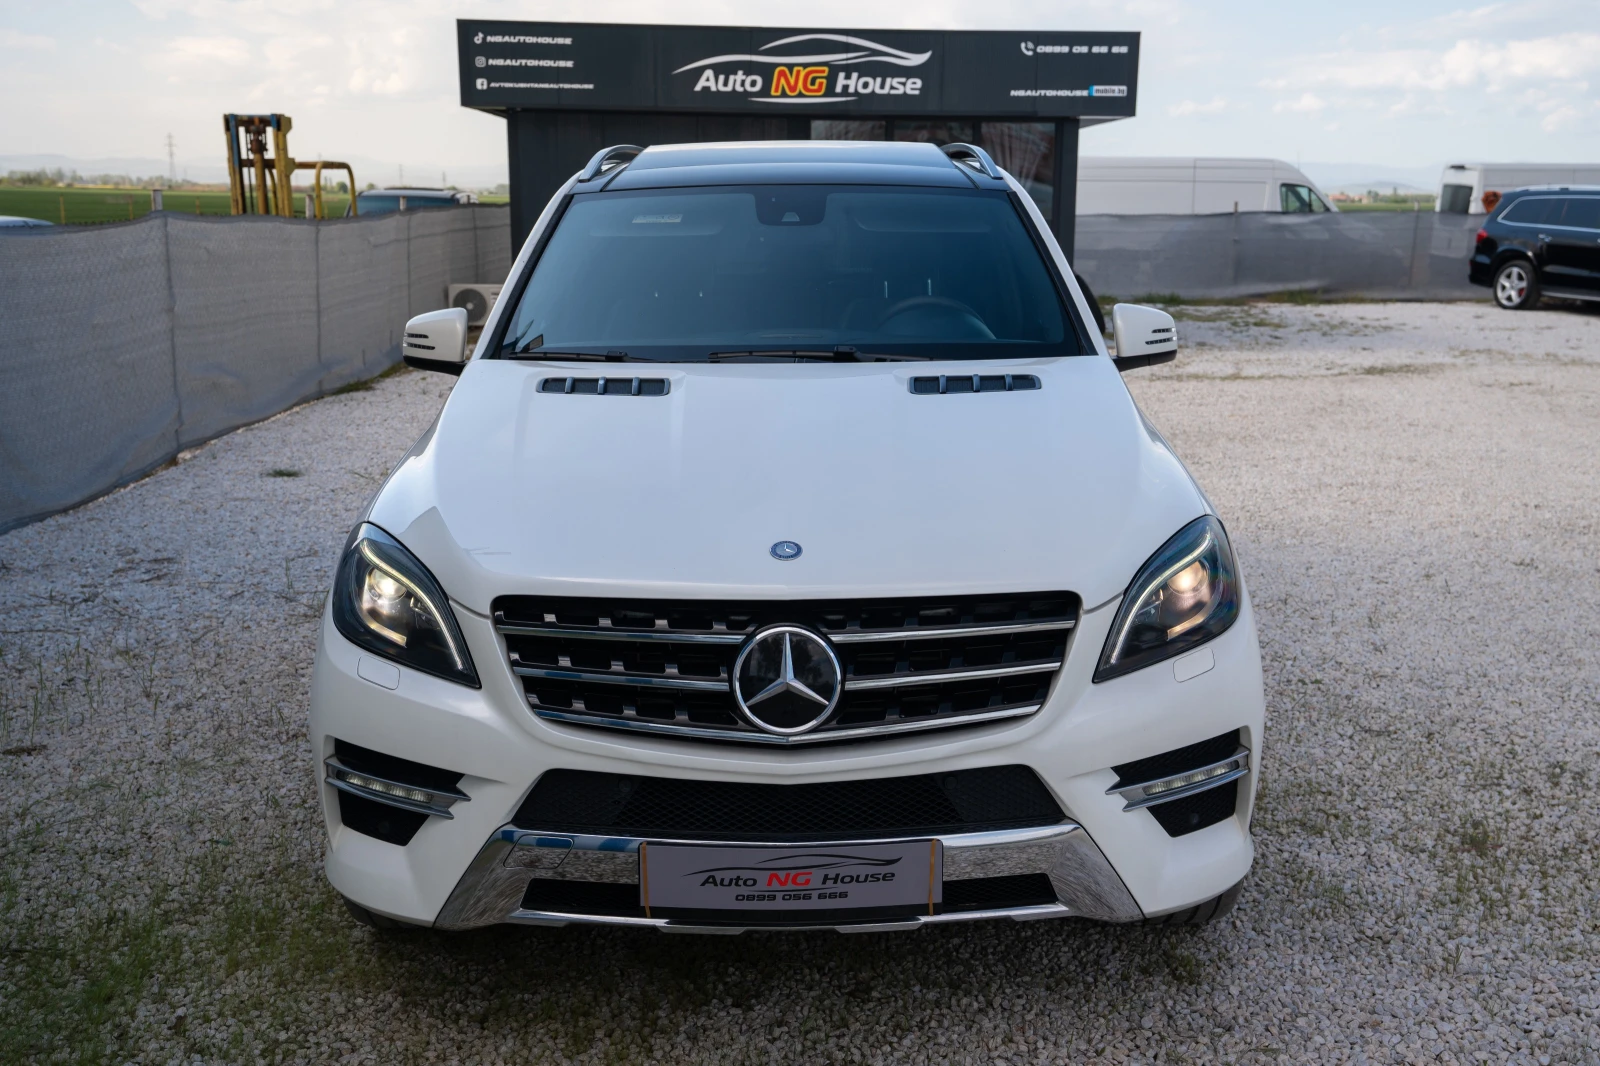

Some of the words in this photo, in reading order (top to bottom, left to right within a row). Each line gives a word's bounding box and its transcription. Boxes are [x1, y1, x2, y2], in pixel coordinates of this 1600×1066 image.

[486, 35, 573, 45] NGAUTOHOUSE
[1036, 45, 1070, 53] 0899
[1072, 45, 1089, 53] 05
[1091, 45, 1109, 53] 66
[1111, 45, 1129, 53] 66
[487, 58, 575, 67] NGAUTOHOUSE
[693, 69, 763, 92] Auto
[770, 66, 829, 96] NG
[834, 72, 923, 95] House
[700, 874, 757, 887] Auto
[766, 871, 813, 887] NG
[821, 871, 896, 885] House
[734, 893, 777, 902] 0899
[781, 892, 812, 901] 056
[817, 891, 849, 900] 666
